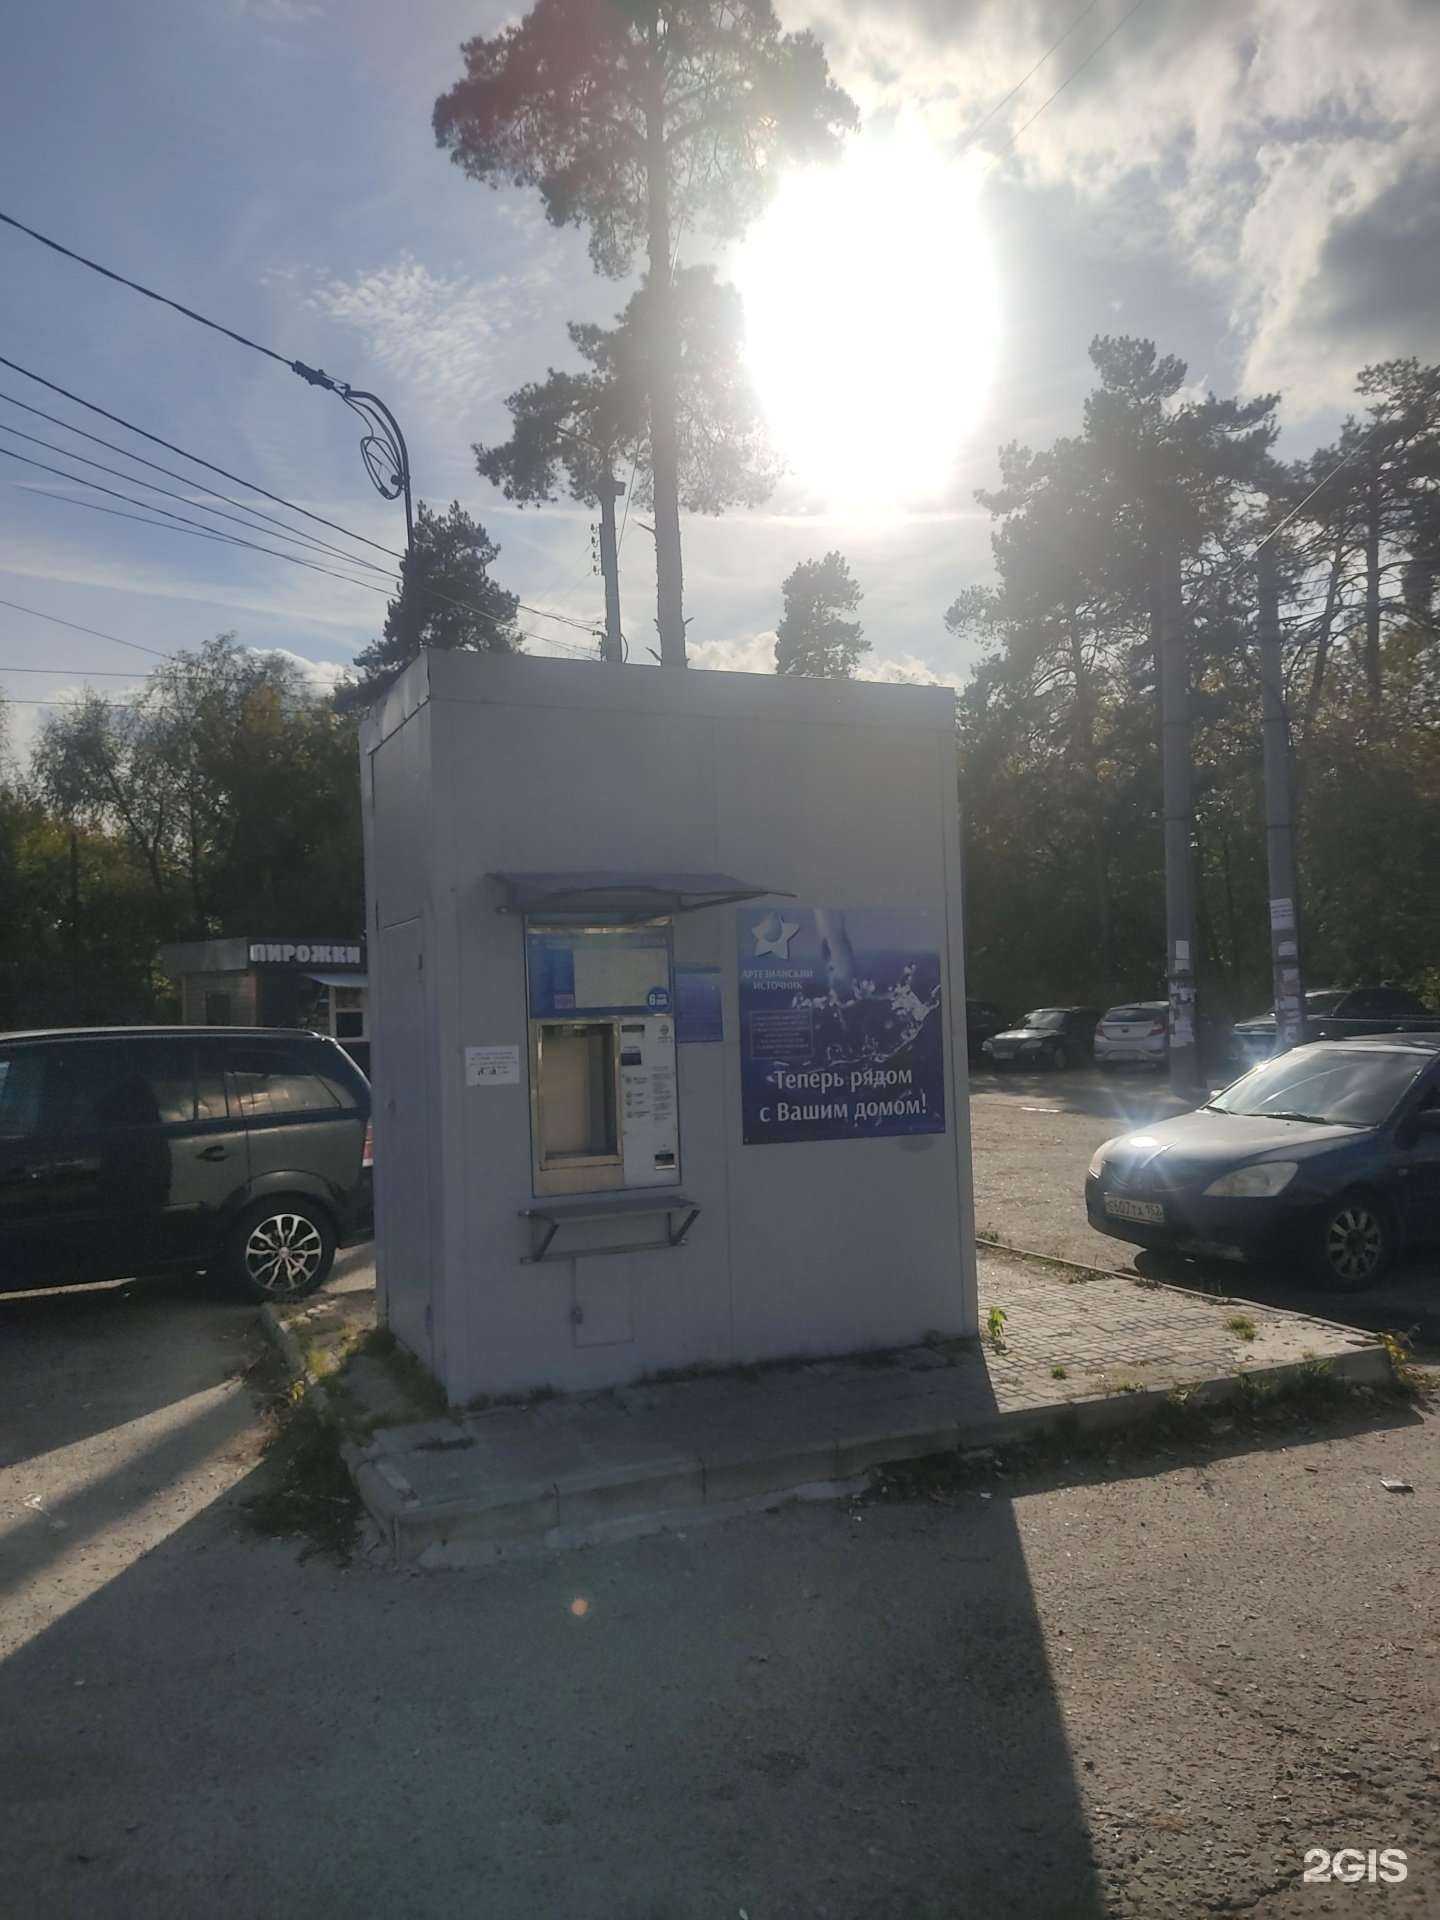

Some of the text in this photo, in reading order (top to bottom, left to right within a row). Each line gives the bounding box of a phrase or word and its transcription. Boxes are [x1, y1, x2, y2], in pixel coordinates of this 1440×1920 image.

[250, 944, 360, 964] ПИРОЖКИ
[774, 1069, 913, 1094] Теперь рядом
[759, 1092, 927, 1122] с Вашим домом!
